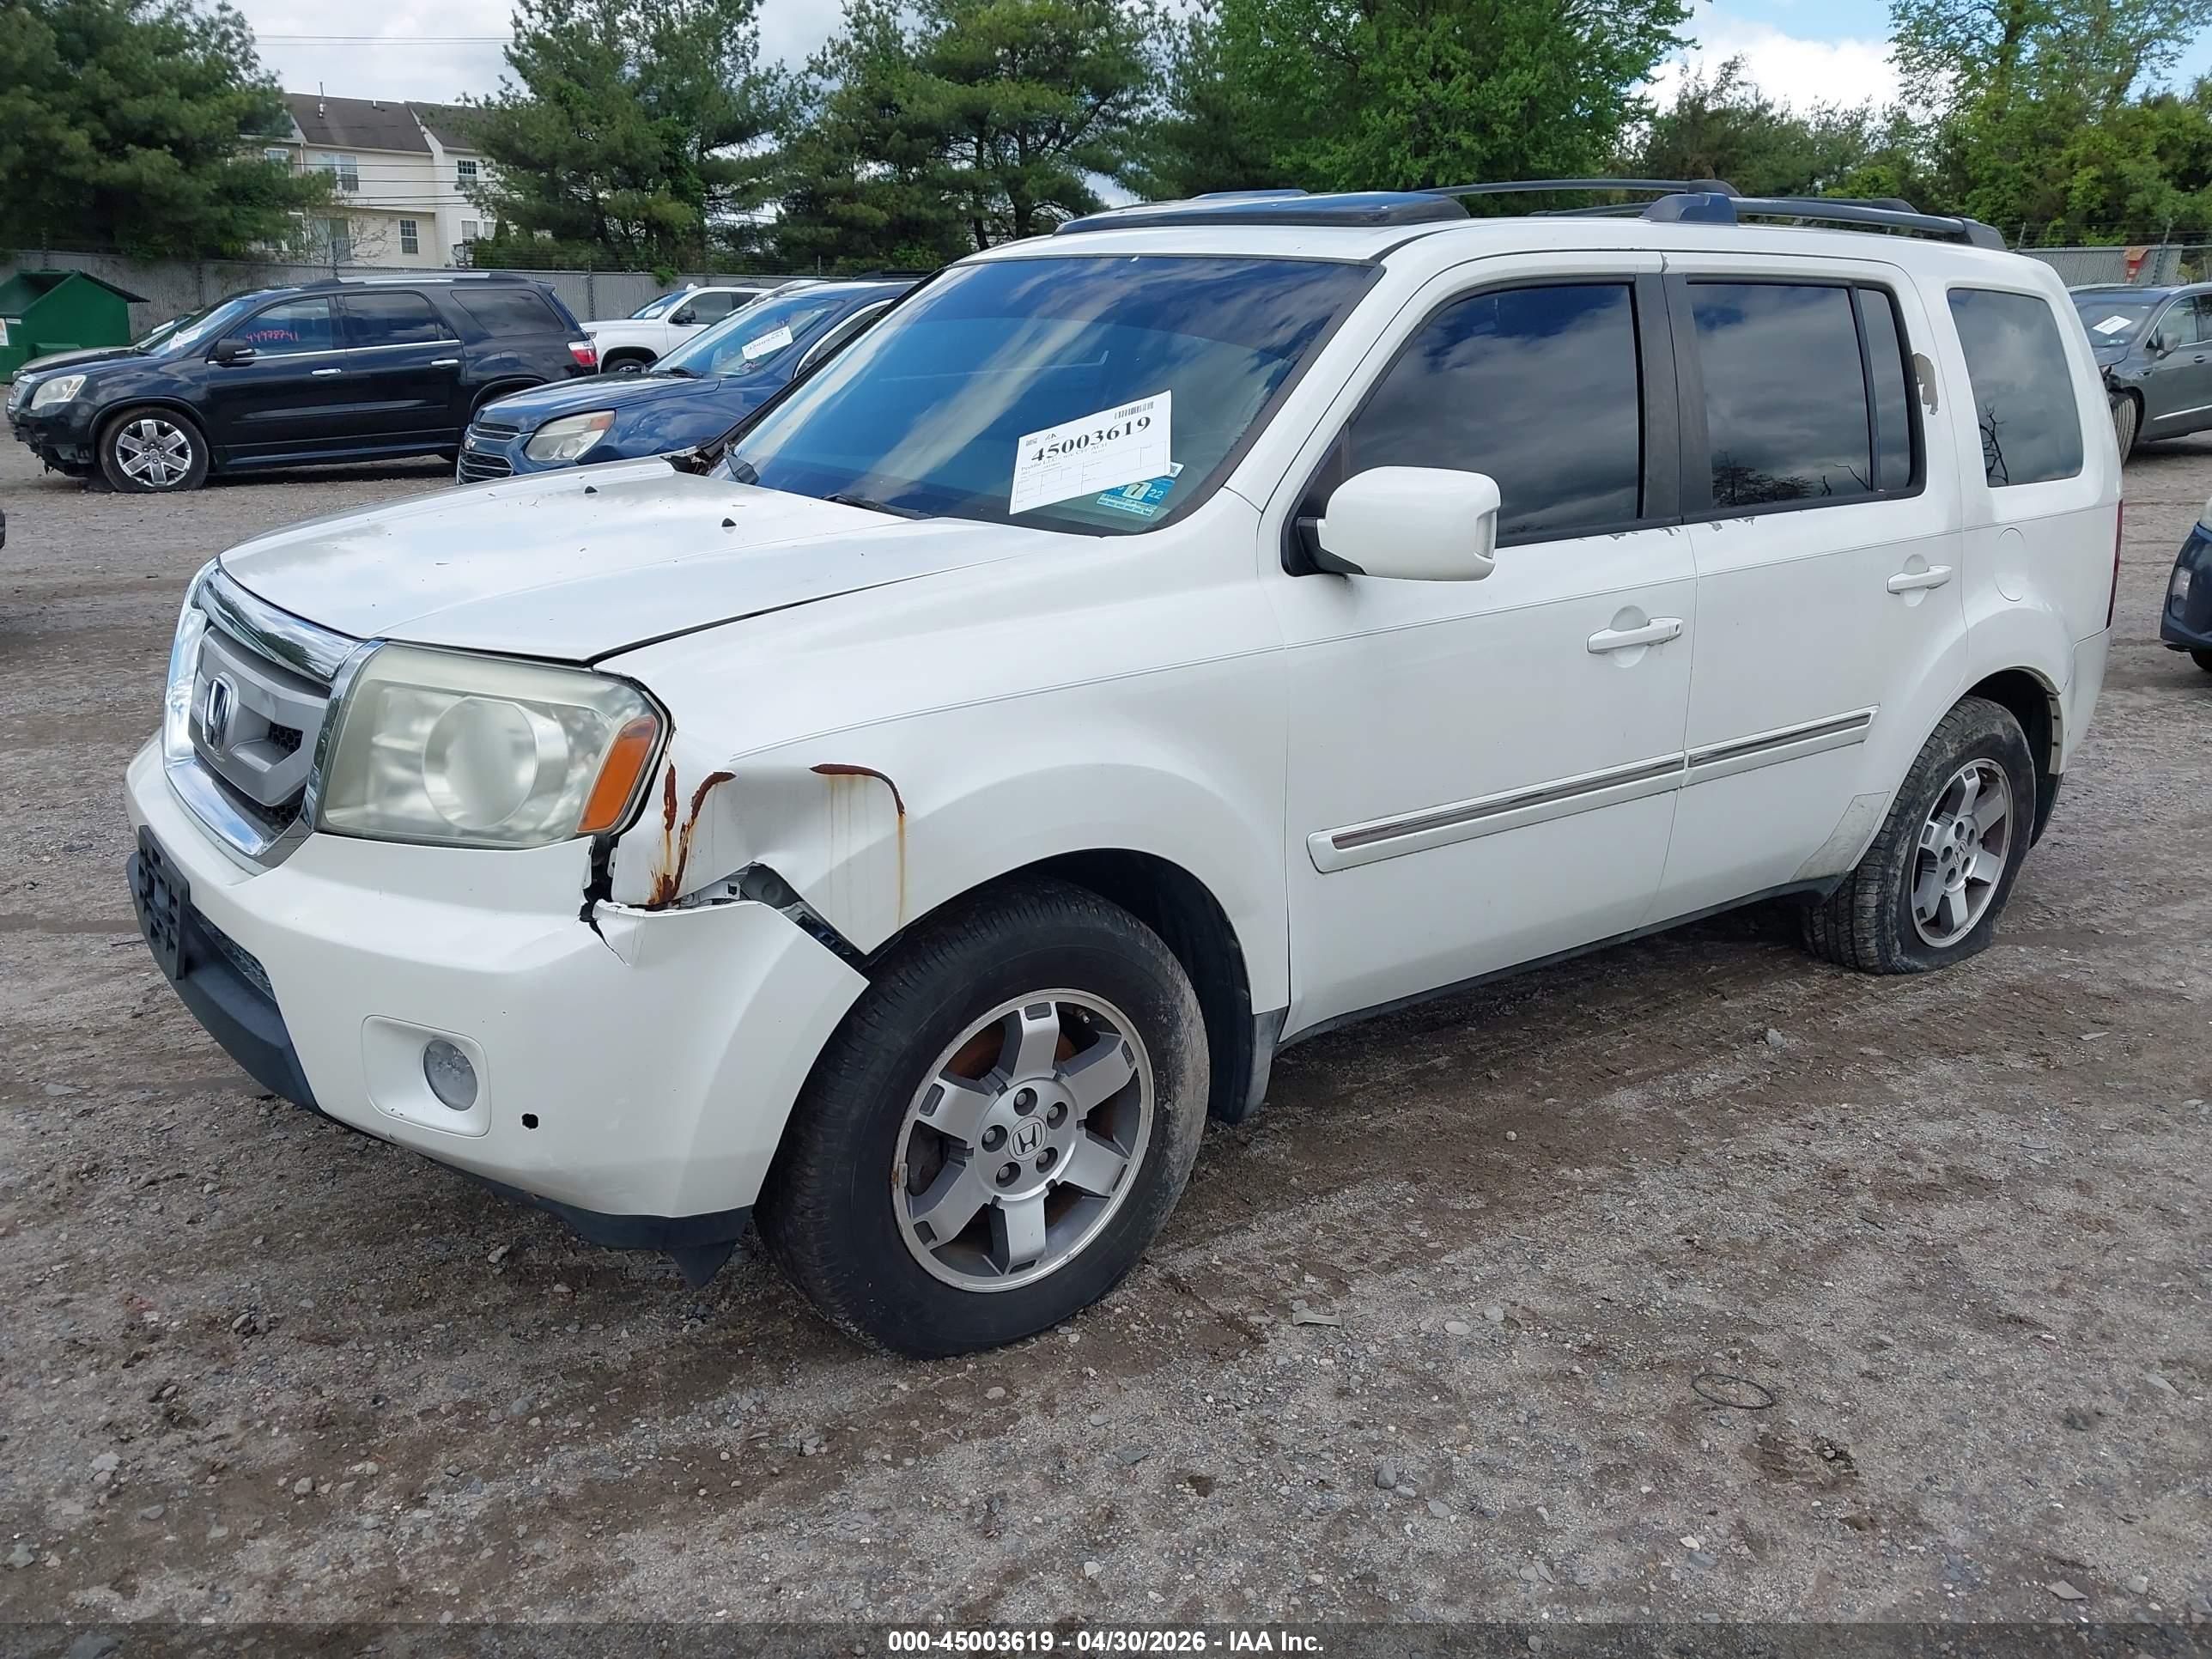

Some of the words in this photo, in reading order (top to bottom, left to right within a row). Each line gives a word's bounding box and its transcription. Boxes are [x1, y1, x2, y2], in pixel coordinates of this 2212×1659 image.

[1031, 416, 1151, 461] 45003619
[1131, 483, 1143, 495] 7
[1147, 489, 1164, 499] 22
